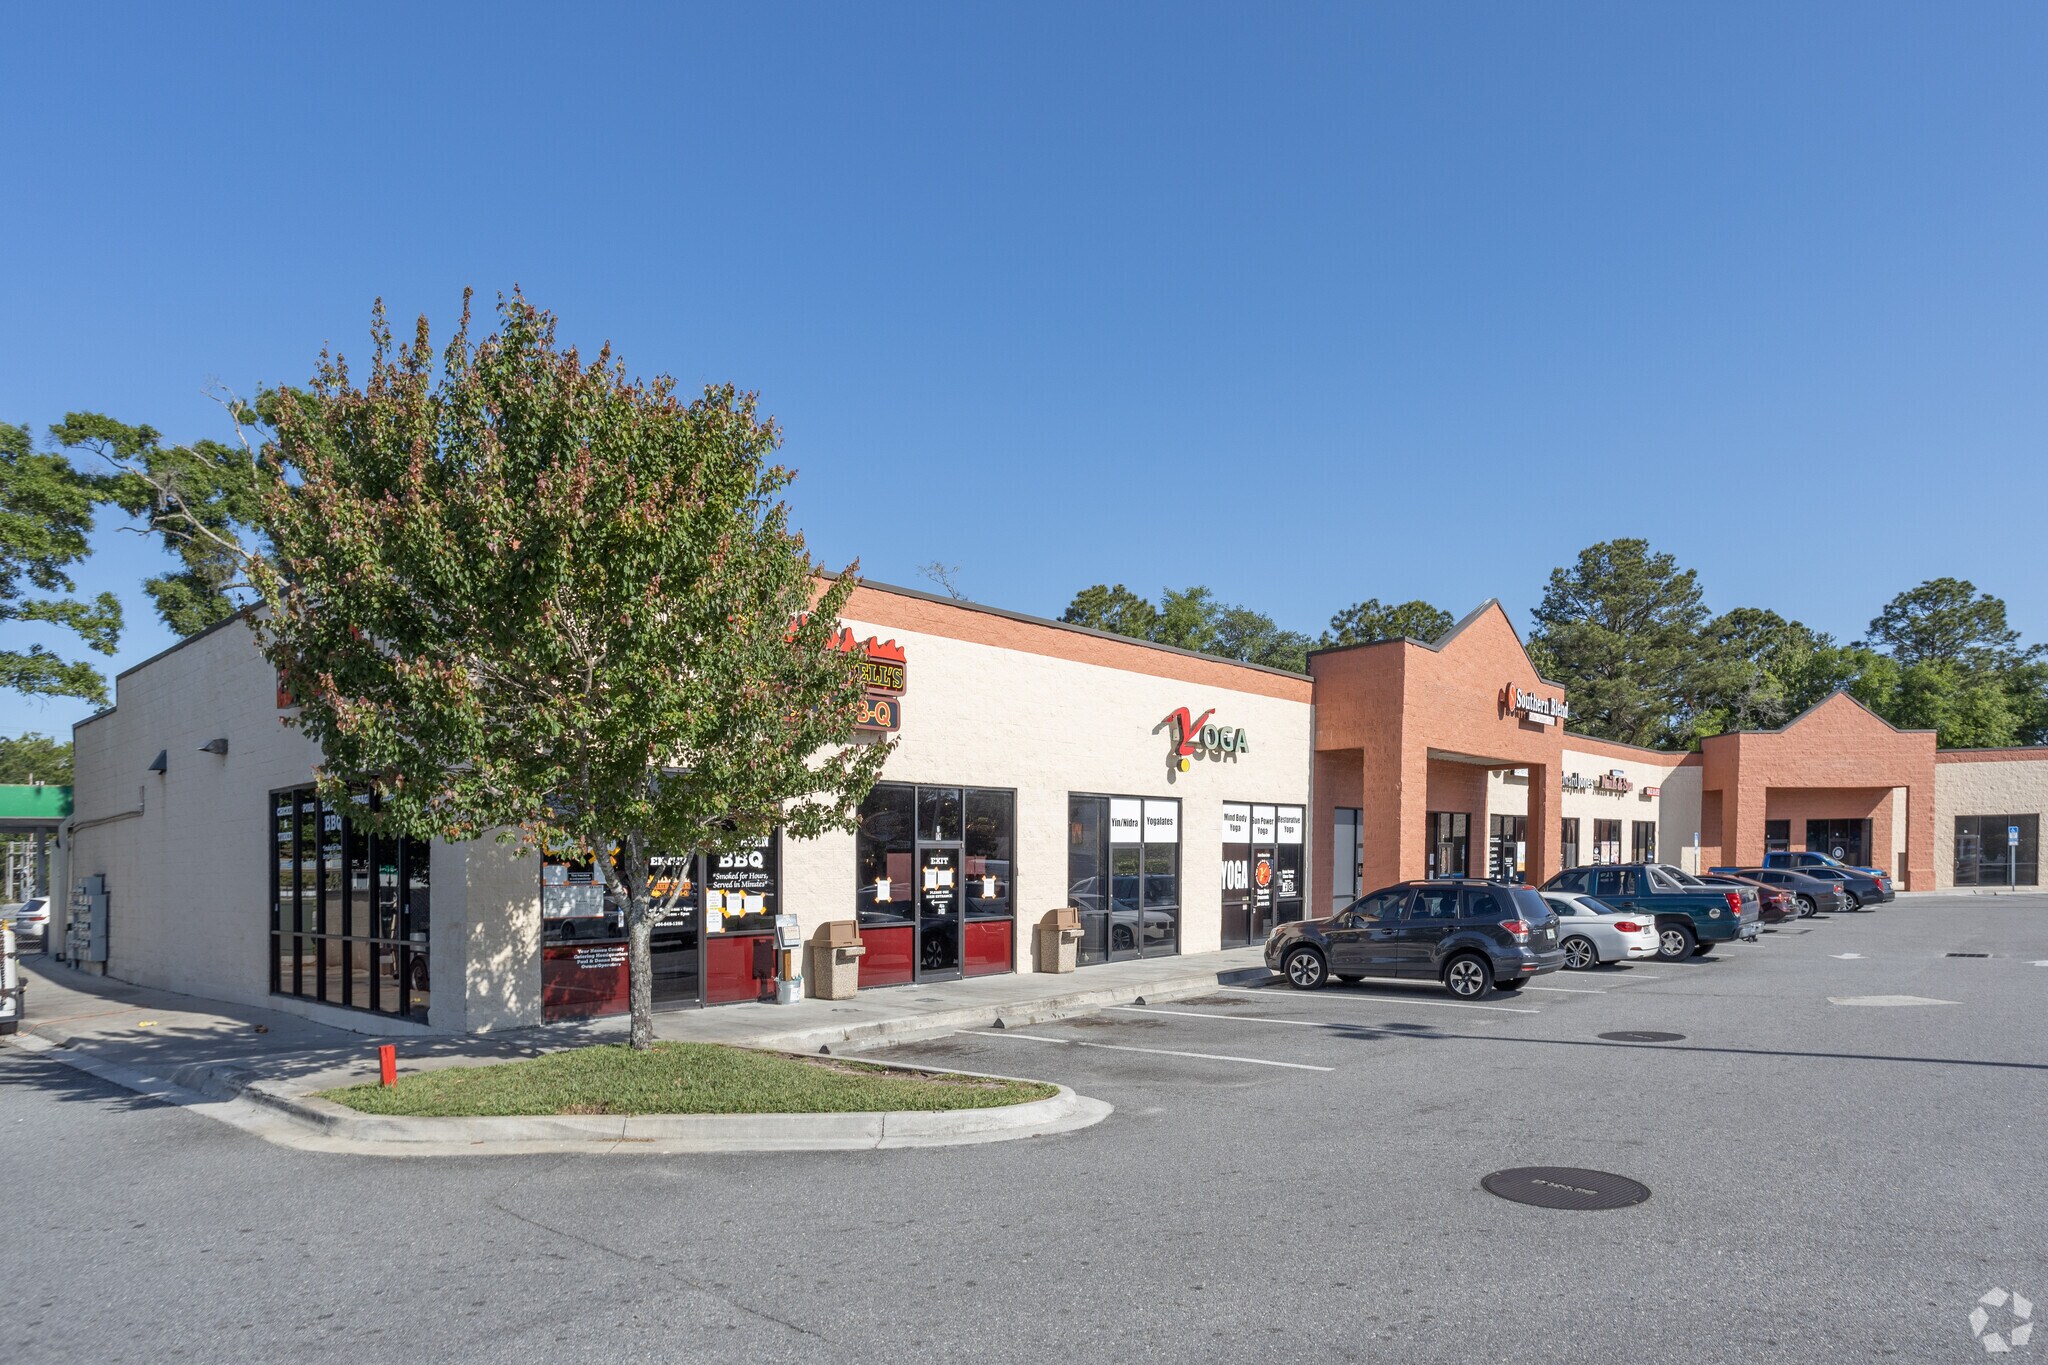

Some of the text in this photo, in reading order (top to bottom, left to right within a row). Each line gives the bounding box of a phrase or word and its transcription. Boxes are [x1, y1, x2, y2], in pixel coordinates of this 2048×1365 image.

[1516, 688, 1549, 714] Southern
[1550, 697, 1568, 719] Blend
[1164, 707, 1249, 755] YOGA
[1147, 817, 1173, 826] Yogalates
[1223, 813, 1247, 822] Mind Body
[1261, 817, 1274, 825] Power
[1111, 818, 1138, 827] Yin/Nidra
[1230, 823, 1241, 832] Yoga
[1257, 827, 1268, 835] Yoga
[1284, 825, 1294, 834] Yoga
[719, 851, 764, 869] BBQ
[930, 857, 948, 865] EXIT
[749, 872, 769, 880] Hours,
[1221, 860, 1249, 890] YOGA
[713, 880, 733, 888] Served
